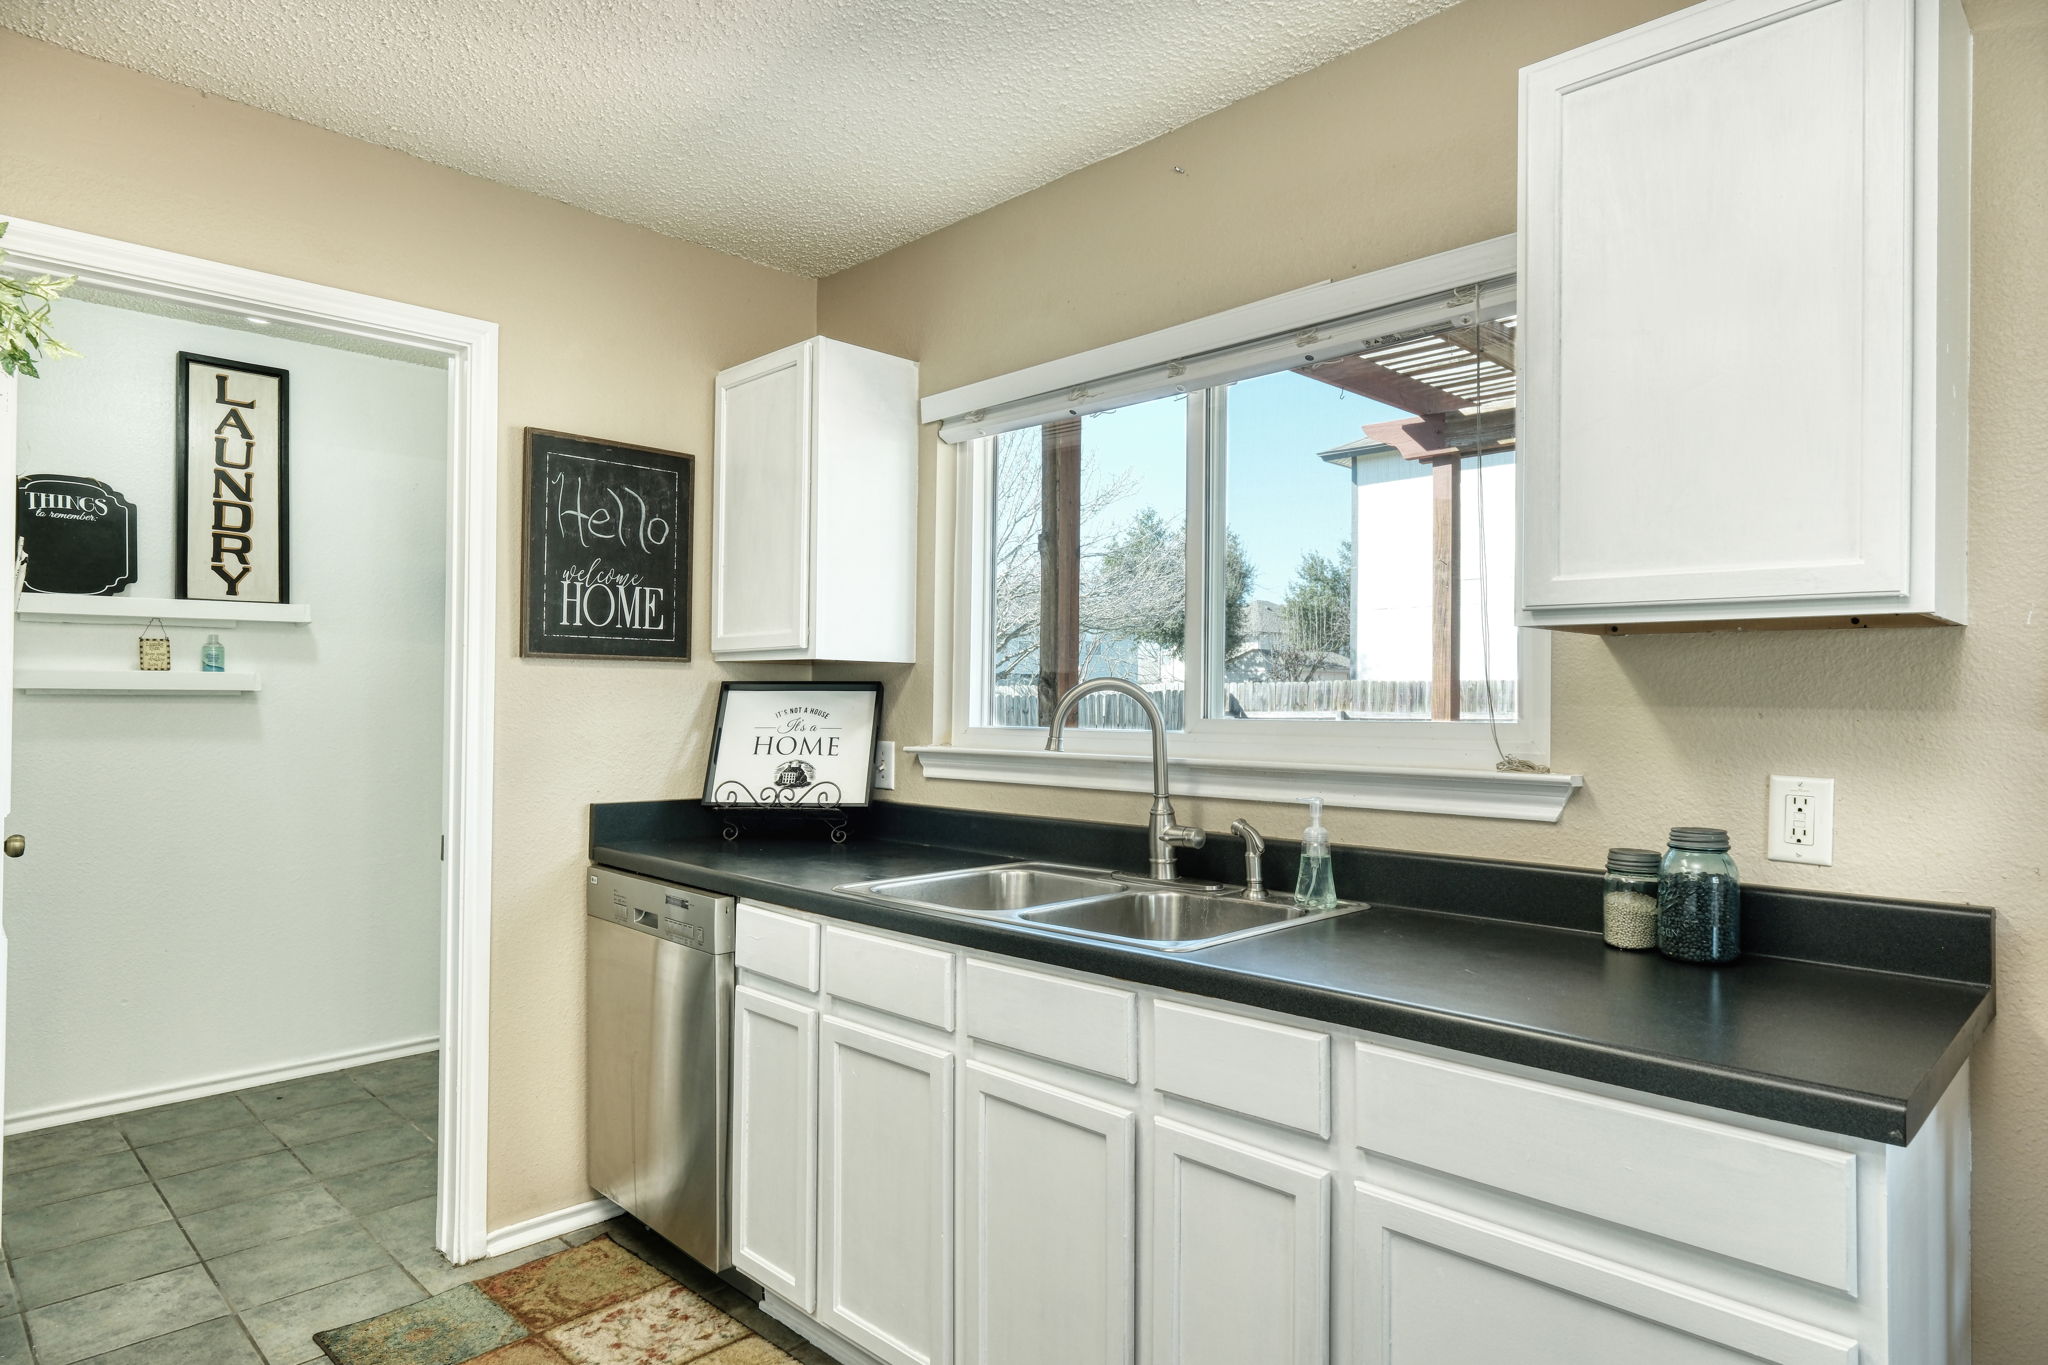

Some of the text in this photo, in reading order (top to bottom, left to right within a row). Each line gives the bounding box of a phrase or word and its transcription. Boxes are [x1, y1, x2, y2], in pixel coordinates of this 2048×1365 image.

[211, 374, 256, 596] LAUNDRY
[24, 491, 108, 516] THINGS
[35, 508, 47, 517] to
[551, 472, 669, 555] Hello
[562, 557, 644, 588] welcome
[560, 580, 664, 630] HOME
[777, 717, 806, 734] It's
[810, 708, 830, 719] HOUSE
[754, 736, 840, 756] HOME
